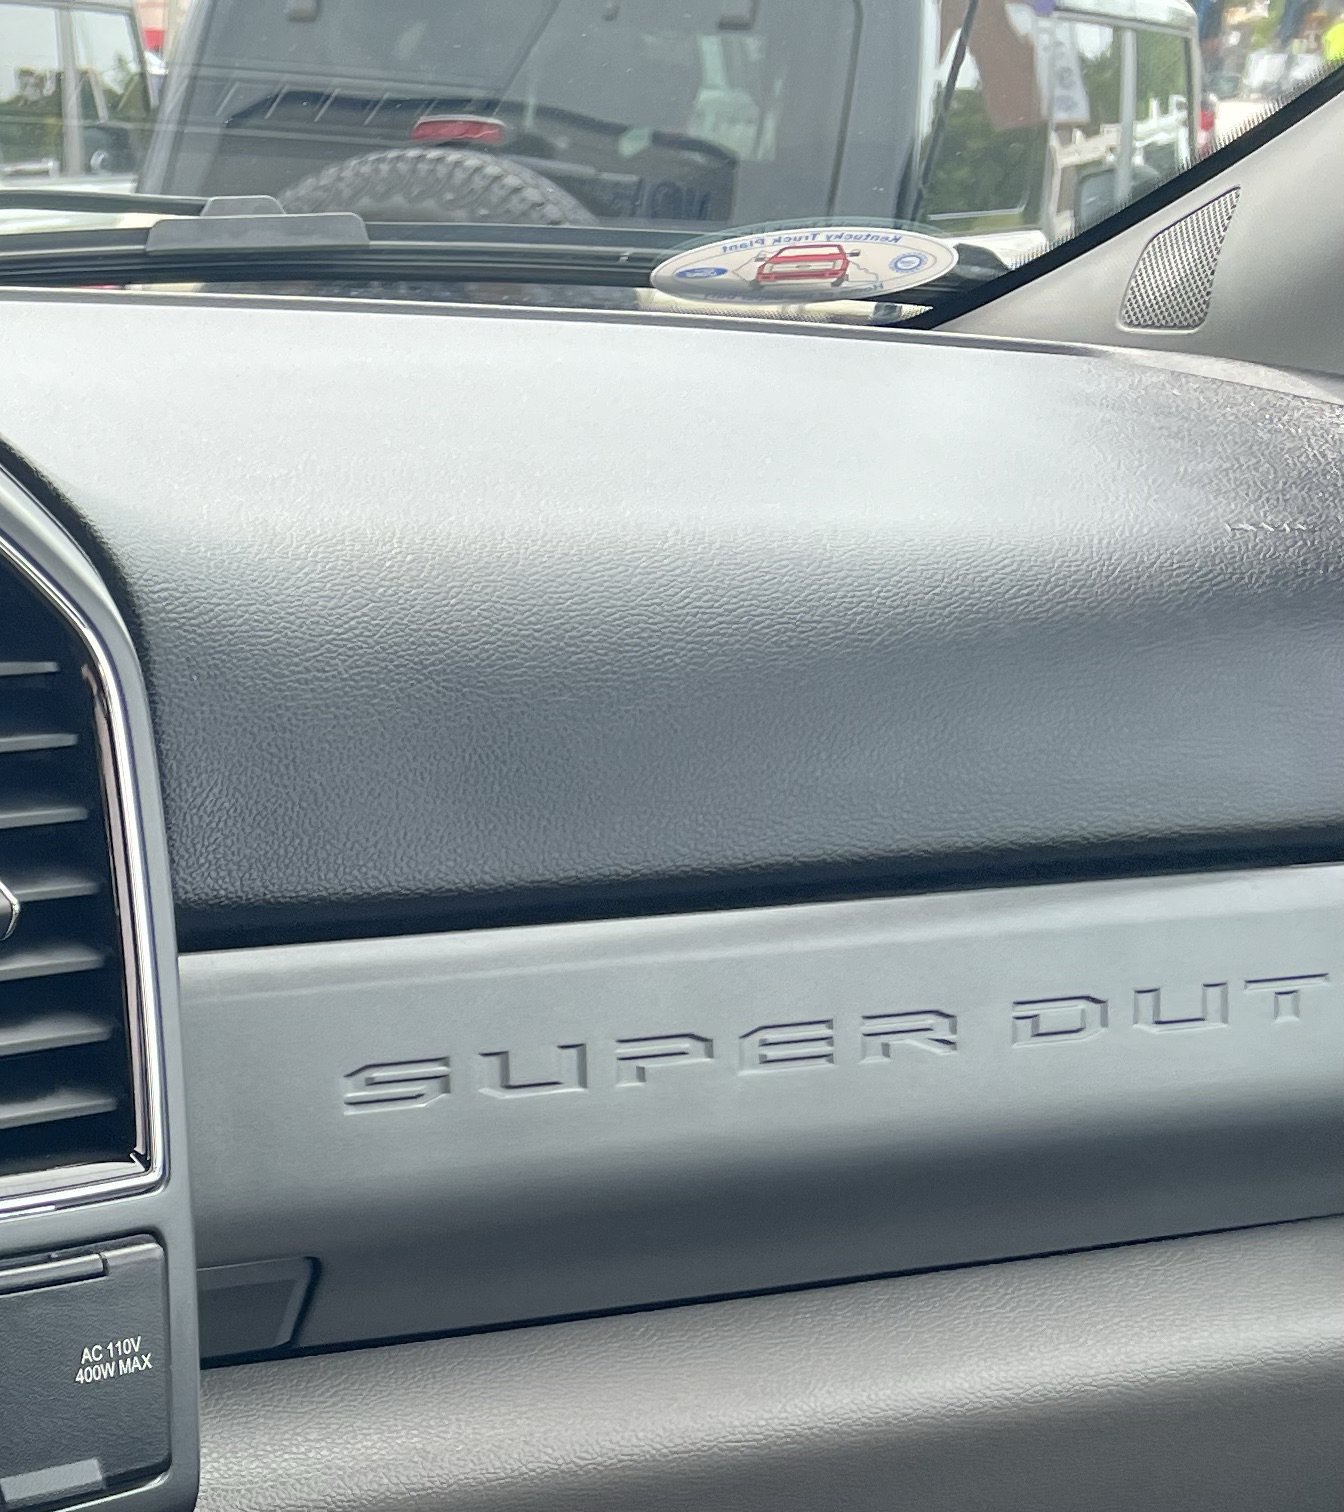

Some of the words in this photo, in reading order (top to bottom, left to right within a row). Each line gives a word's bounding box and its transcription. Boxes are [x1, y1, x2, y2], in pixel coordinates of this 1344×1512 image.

[342, 1007, 959, 1117] SUPER
[1010, 971, 1332, 1051] DUT
[81, 1344, 104, 1365] AC
[107, 1335, 142, 1358] 110V
[74, 1361, 116, 1385] 400W
[118, 1352, 153, 1376] MAX
